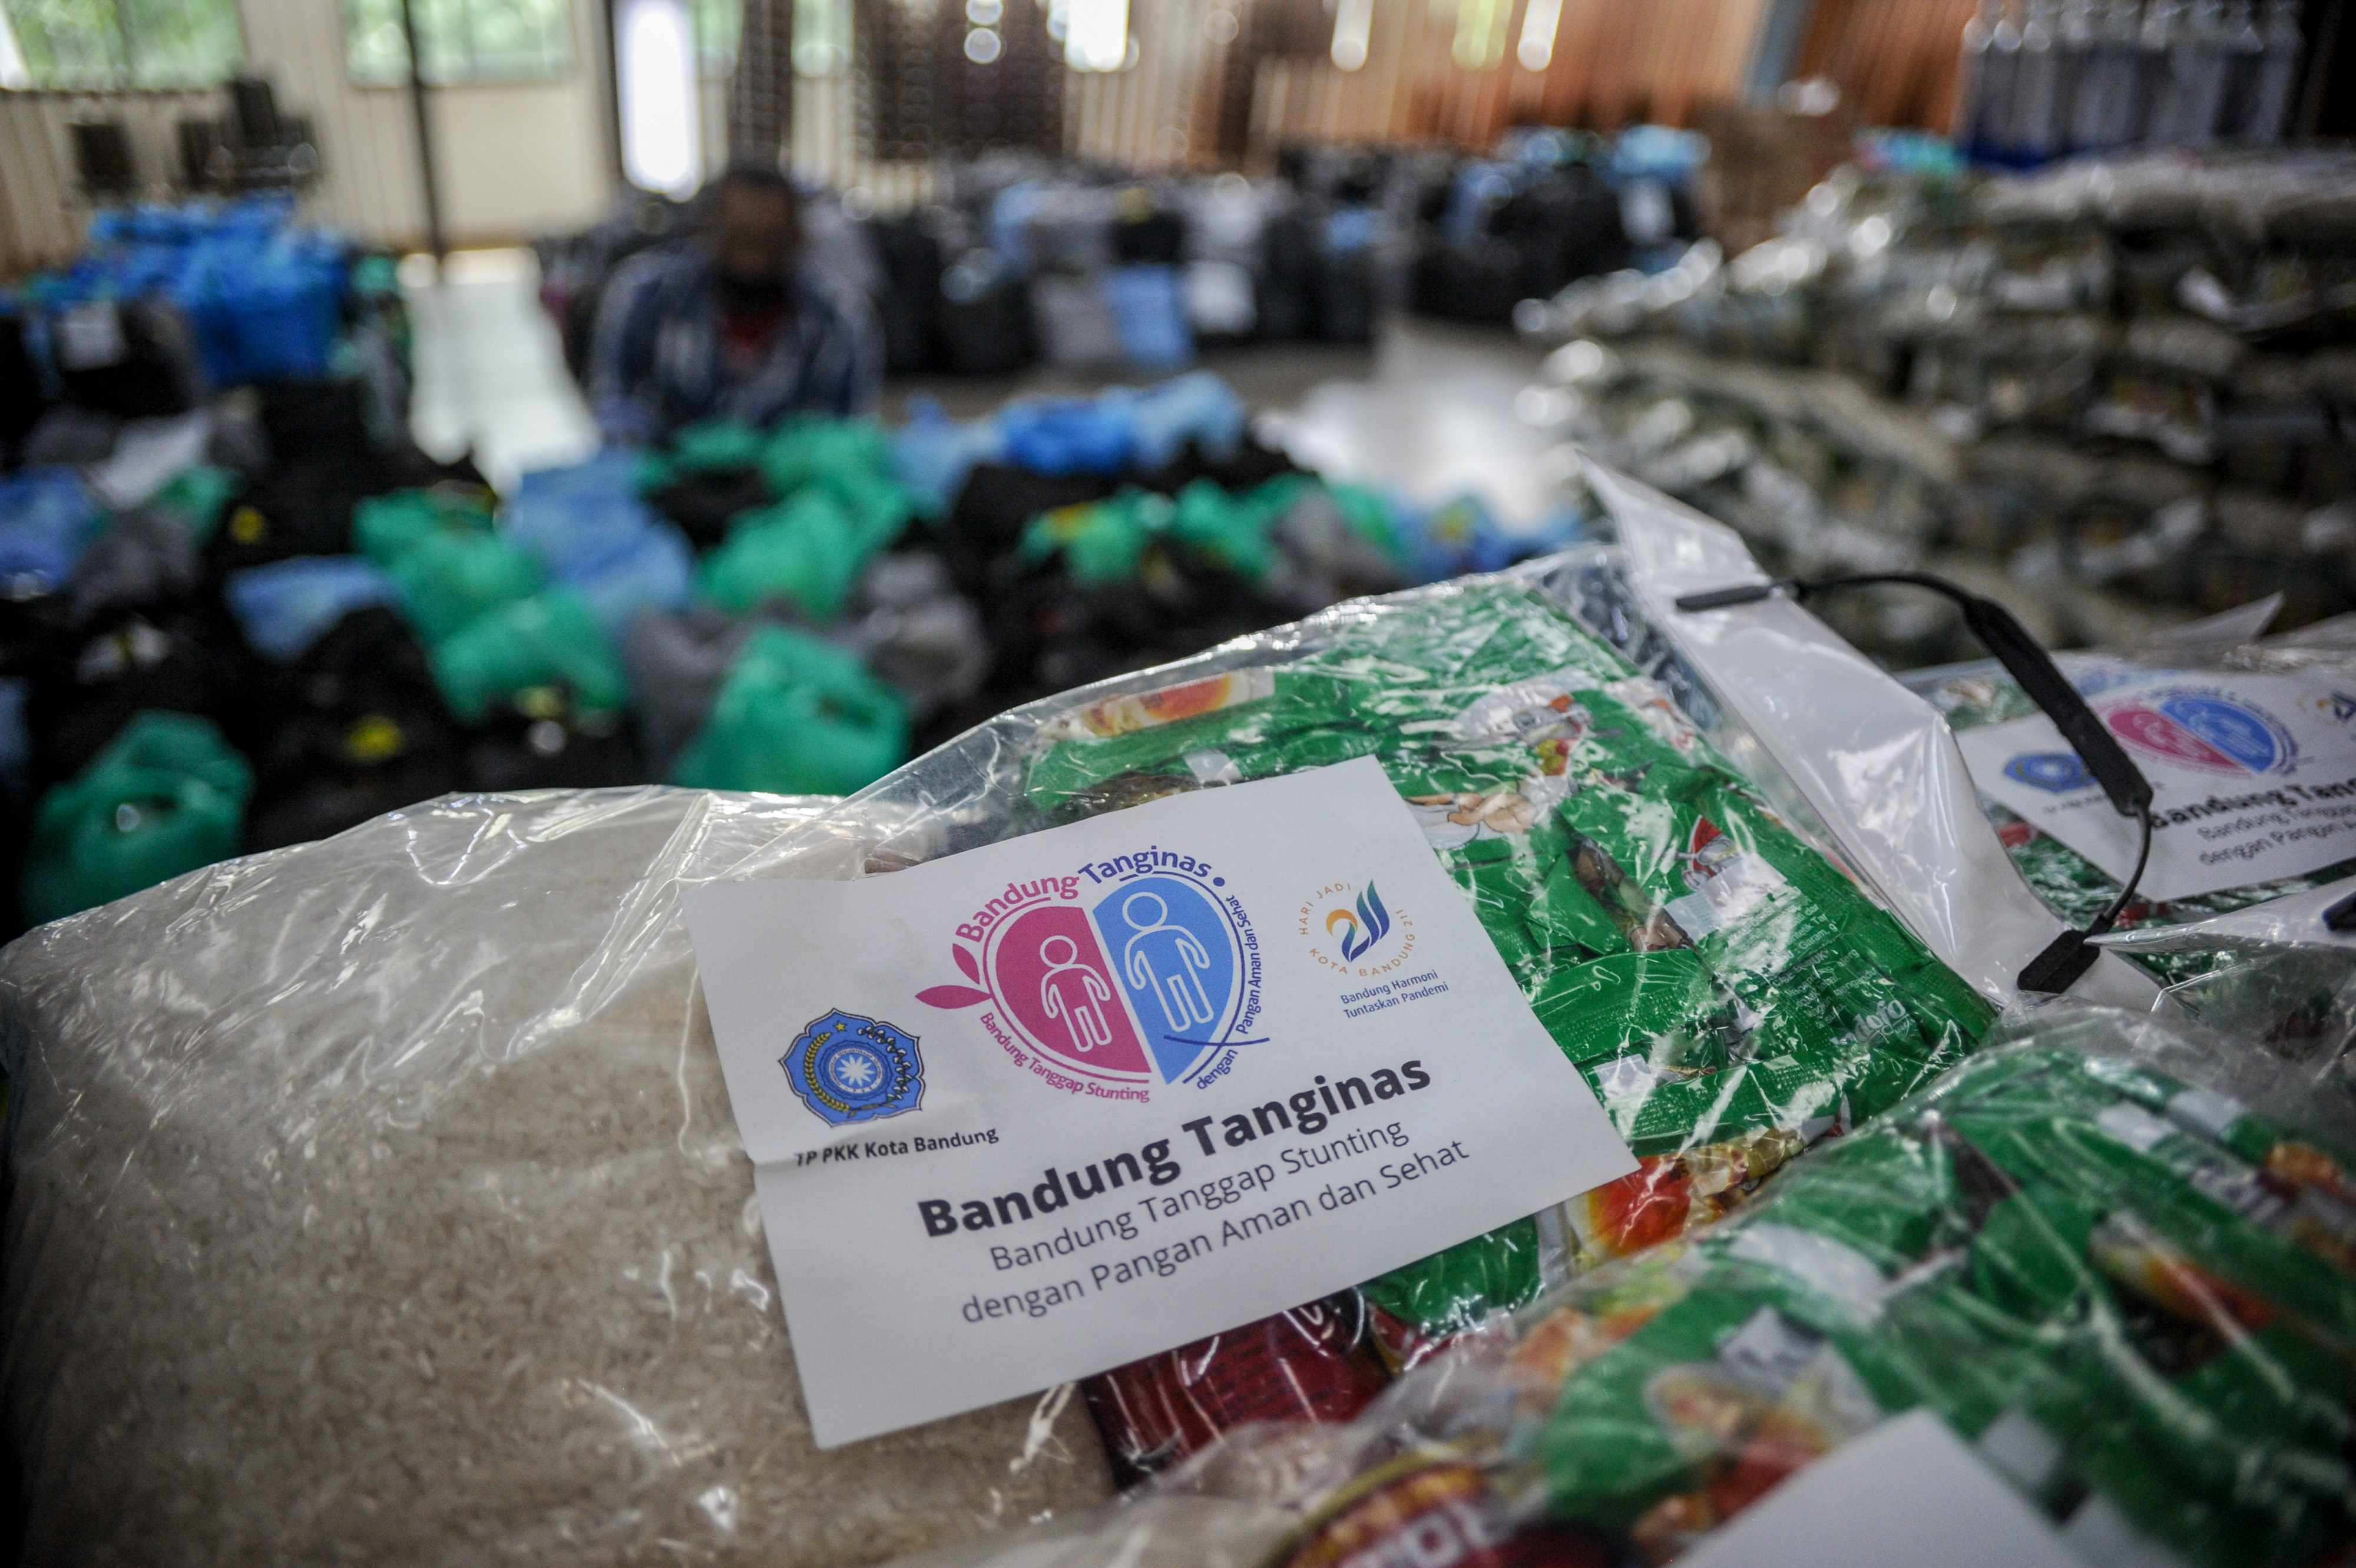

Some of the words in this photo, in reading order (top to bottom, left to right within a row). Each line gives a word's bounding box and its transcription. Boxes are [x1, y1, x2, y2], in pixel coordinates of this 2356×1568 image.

[955, 876, 1079, 942] Bandung
[1078, 846, 1212, 884] Tanginas
[1226, 894, 1251, 928] Sehat
[1299, 901, 1314, 935] HARI
[1317, 883, 1351, 899] JADI
[1245, 928, 1259, 950] dan
[1309, 948, 1348, 975] KOTA
[1359, 934, 1415, 976] BANDUNG
[1248, 952, 1262, 988] Aman
[1341, 984, 1391, 1004] Bandung
[1391, 969, 1438, 990] Harmoni
[1236, 989, 1261, 1034] Pangan
[1344, 997, 1400, 1018] Tuntaskan
[1401, 981, 1449, 1002] Pandemi
[980, 1012, 1029, 1067] Bandung
[1028, 1057, 1084, 1094] Tanggap
[1085, 1082, 1150, 1103] Stunting
[1197, 1049, 1237, 1090] dengan
[822, 1143, 859, 1163] PKK
[865, 1140, 909, 1157] Kota
[914, 1128, 999, 1153] Bandung
[917, 1139, 1181, 1238] Bandung
[1182, 1060, 1431, 1156] Tanginas
[990, 1212, 1139, 1271] Bandung
[1137, 1163, 1275, 1222] Tanggap
[1280, 1122, 1410, 1175] Stunting
[962, 1278, 1086, 1323] dengan
[1090, 1233, 1212, 1291] Pangan
[1221, 1199, 1312, 1246] Aman
[1318, 1179, 1377, 1211] dan
[1379, 1140, 1470, 1189] Sehat
